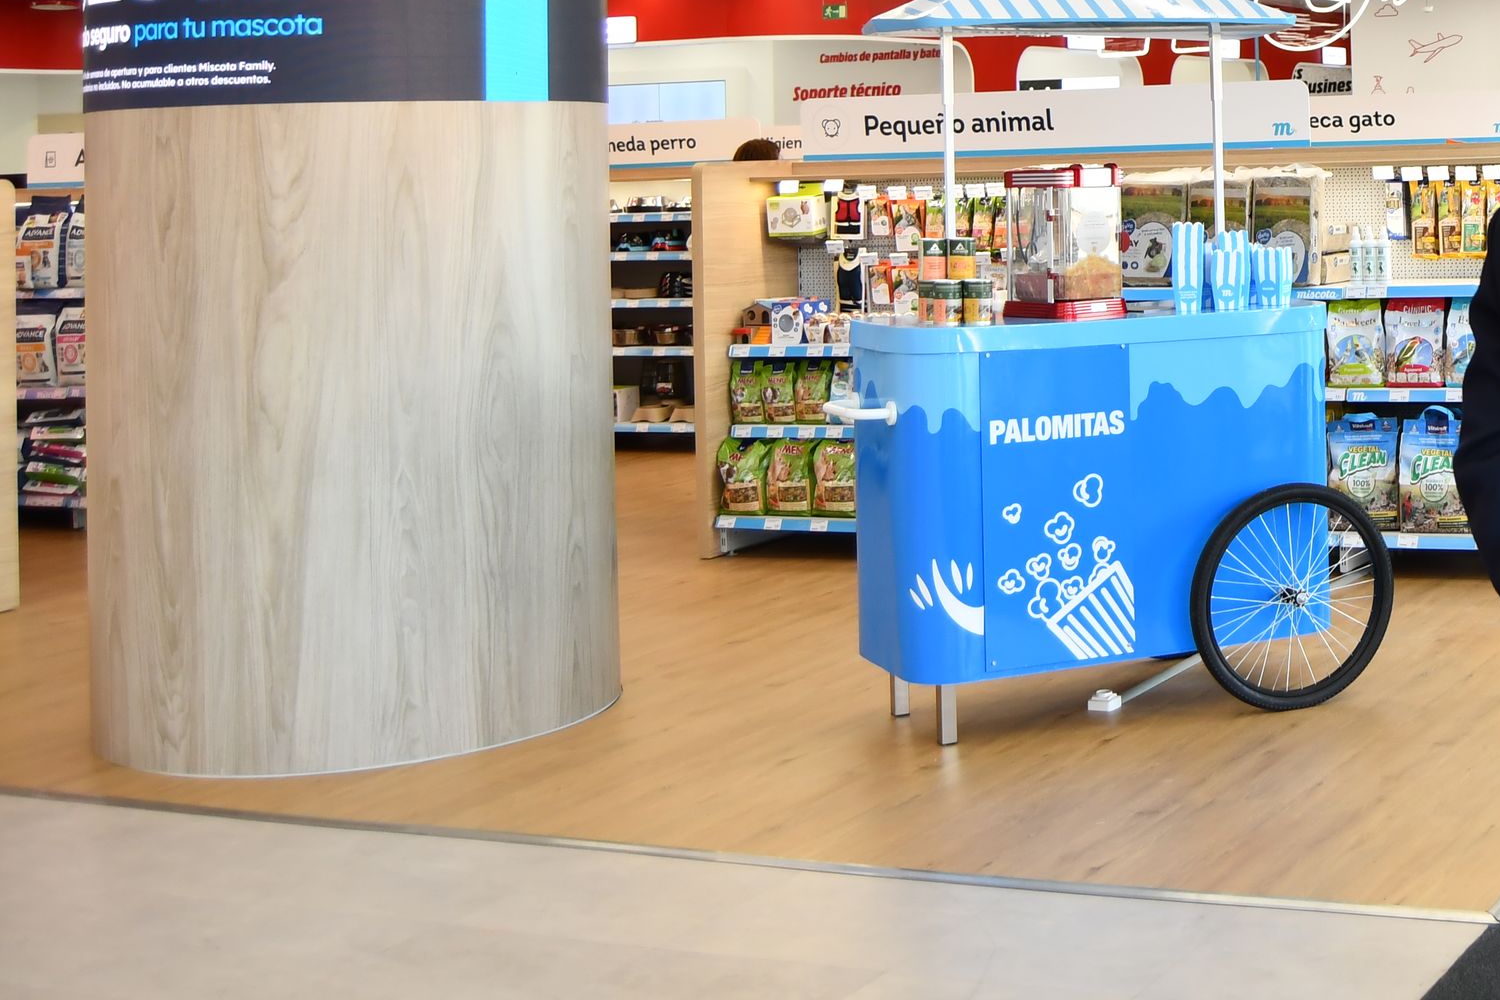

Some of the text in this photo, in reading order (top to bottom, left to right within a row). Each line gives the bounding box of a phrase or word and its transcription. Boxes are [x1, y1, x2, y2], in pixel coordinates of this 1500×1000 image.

[90, 24, 131, 51] seguro
[134, 21, 178, 47] para
[183, 17, 205, 38] tu
[212, 14, 323, 37] mascota
[820, 51, 858, 63] Cambios
[859, 51, 871, 61] de
[872, 48, 911, 62] pantalla
[912, 50, 920, 61] y
[111, 66, 137, 79] apertura
[138, 67, 143, 77] y
[144, 66, 162, 77] para
[163, 63, 197, 74] clientes
[198, 61, 236, 72] Miscota
[239, 60, 276, 73] Family.
[122, 80, 131, 89] No
[132, 77, 175, 89] acumulable
[177, 78, 184, 87] a
[185, 76, 209, 86] otros
[211, 75, 271, 85] descuentos.
[793, 82, 902, 101] Soporte técnico
[1303, 79, 1352, 94] usines
[972, 108, 1055, 132] animal
[1349, 111, 1396, 133] gato
[650, 137, 697, 156] perro
[1296, 289, 1337, 300] miscota
[989, 409, 1125, 446] PALOMITAS
[1348, 445, 1380, 453] VEGETAL
[1421, 449, 1453, 457] VEGETAL
[1339, 450, 1388, 478] CLEAN
[1425, 483, 1444, 491] 100%
